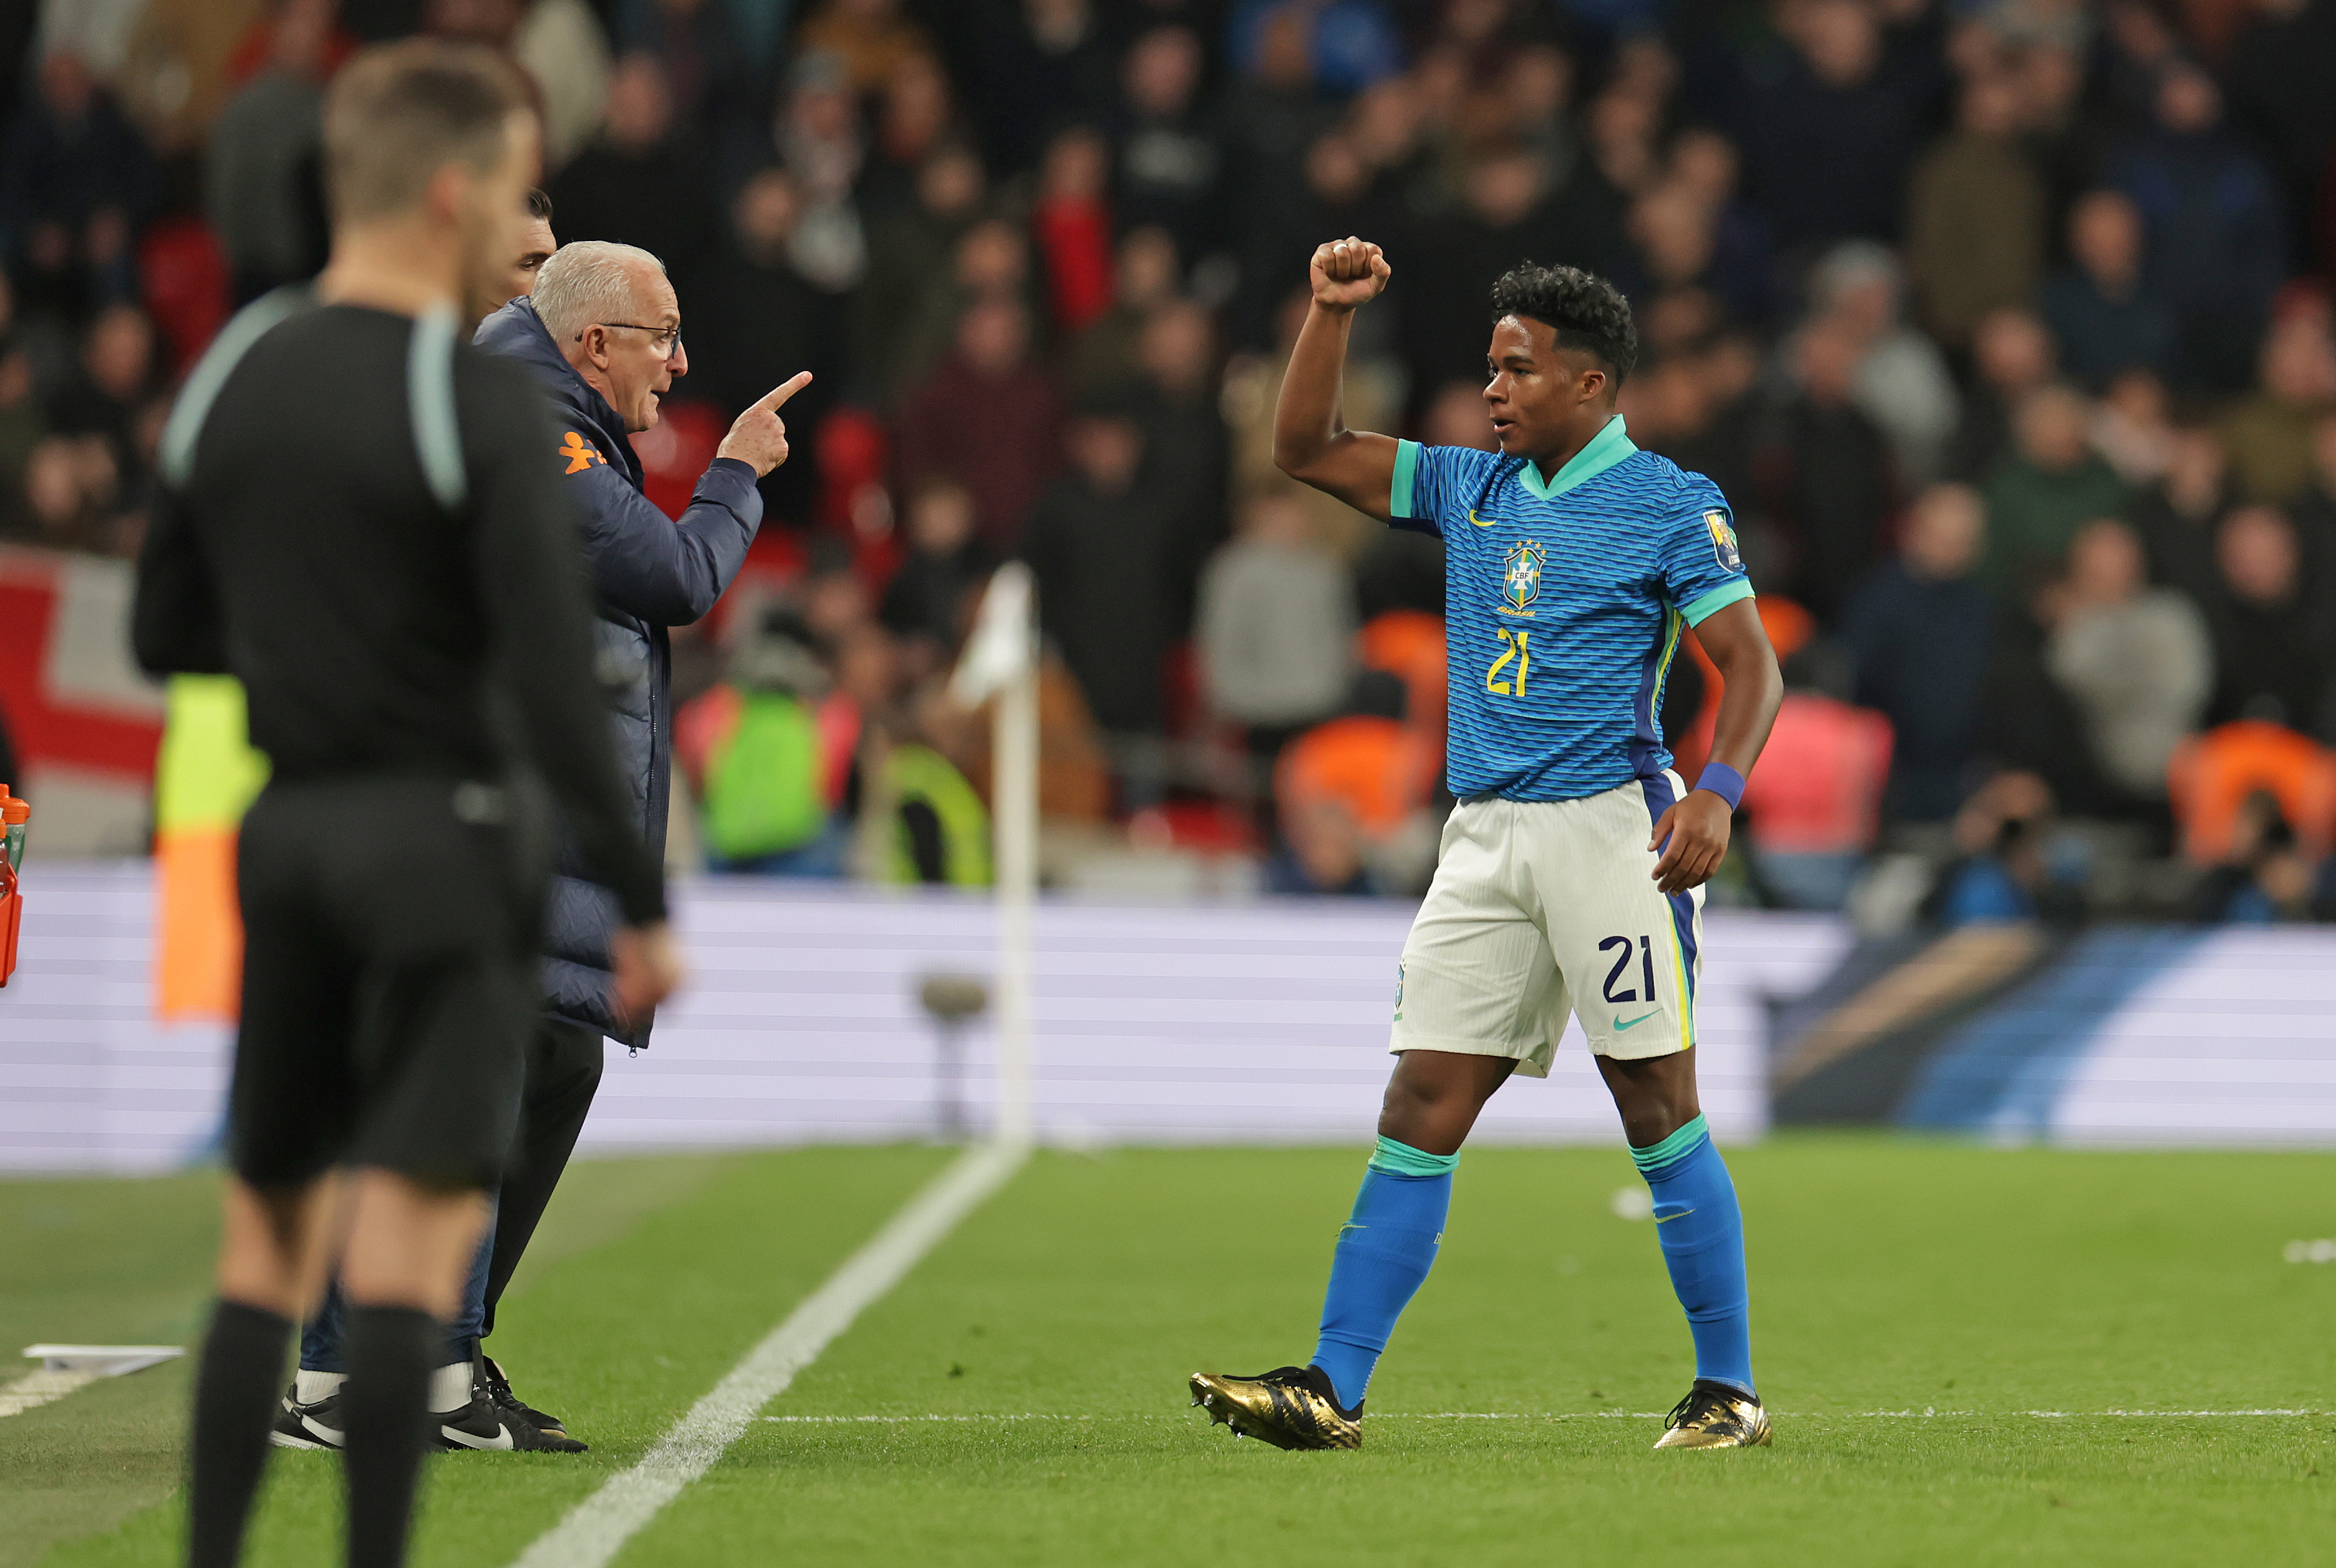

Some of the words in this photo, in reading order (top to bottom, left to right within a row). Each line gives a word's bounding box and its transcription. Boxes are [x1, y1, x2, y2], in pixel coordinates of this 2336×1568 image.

[1496, 606, 1536, 617] BRASIL
[1487, 628, 1529, 697] 21
[1598, 935, 1655, 1003] 21
